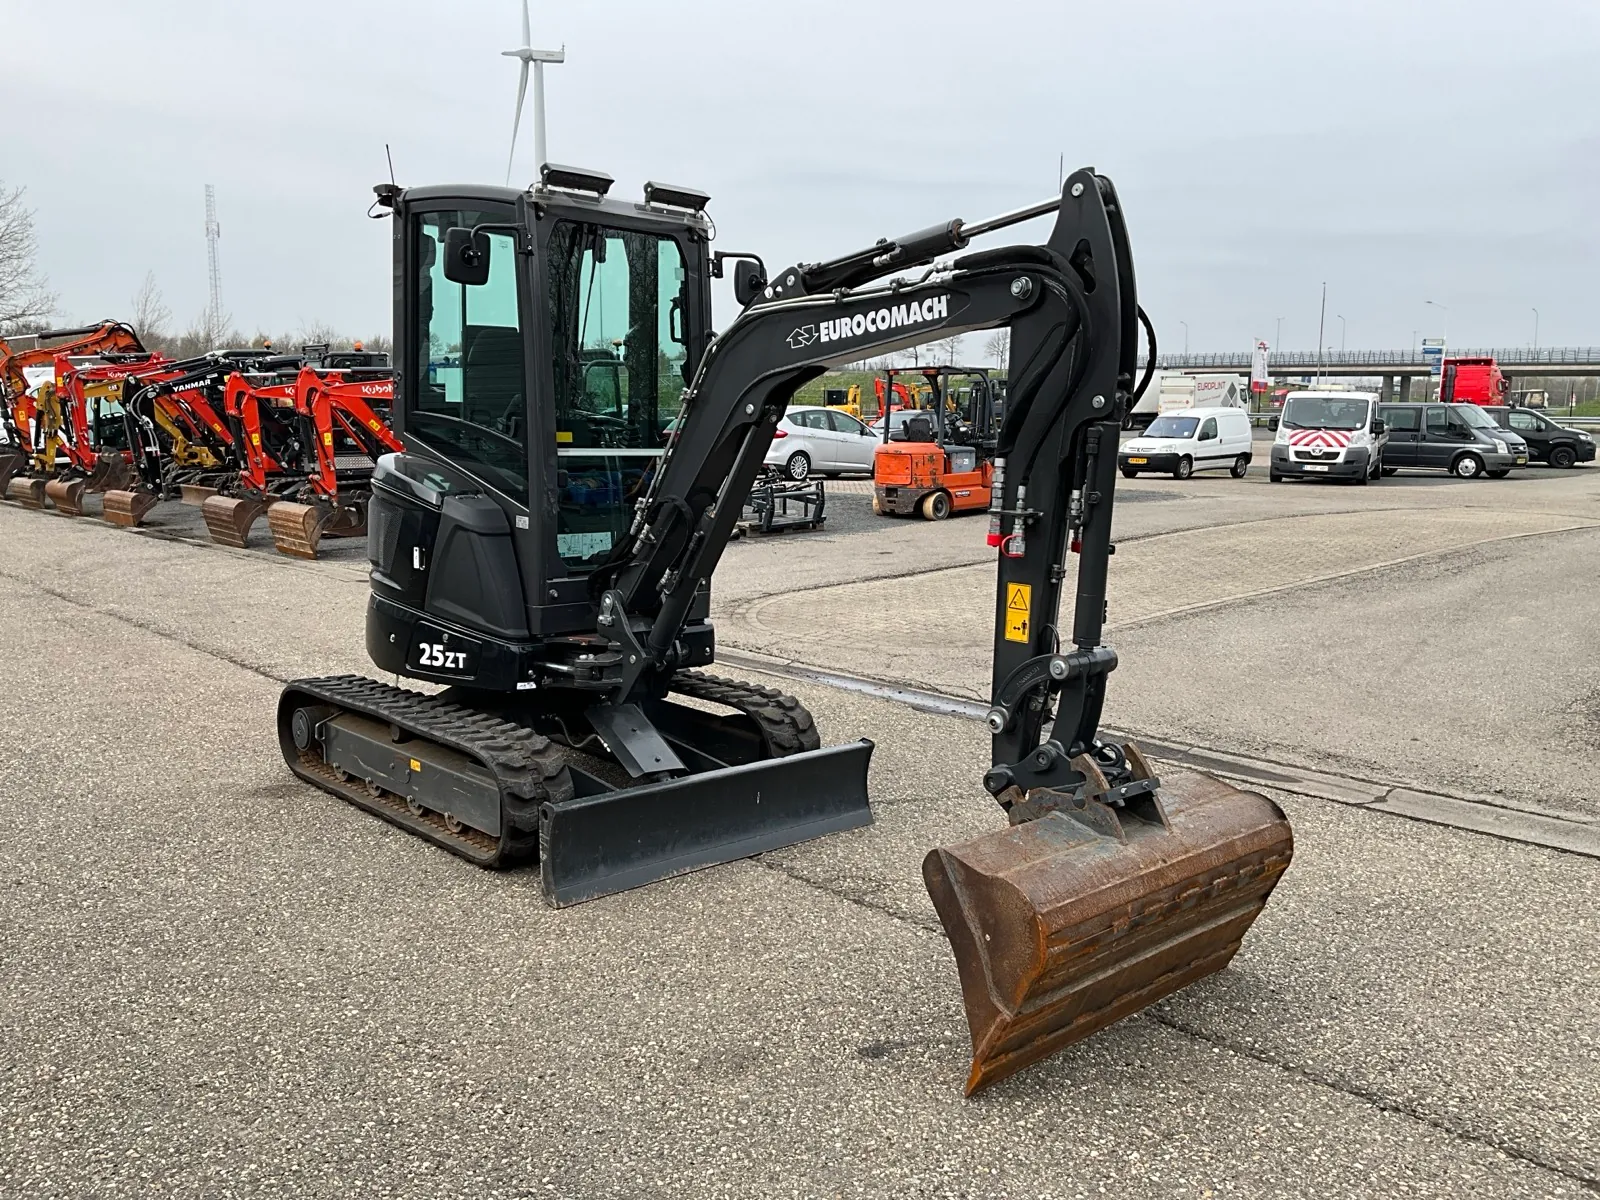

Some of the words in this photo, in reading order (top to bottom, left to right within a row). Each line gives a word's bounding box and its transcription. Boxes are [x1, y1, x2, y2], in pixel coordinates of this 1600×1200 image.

[819, 294, 948, 343] EUROCOMACH
[172, 379, 211, 392] YANMAR
[361, 383, 394, 395] Kubot
[419, 642, 467, 669] 25ZT
